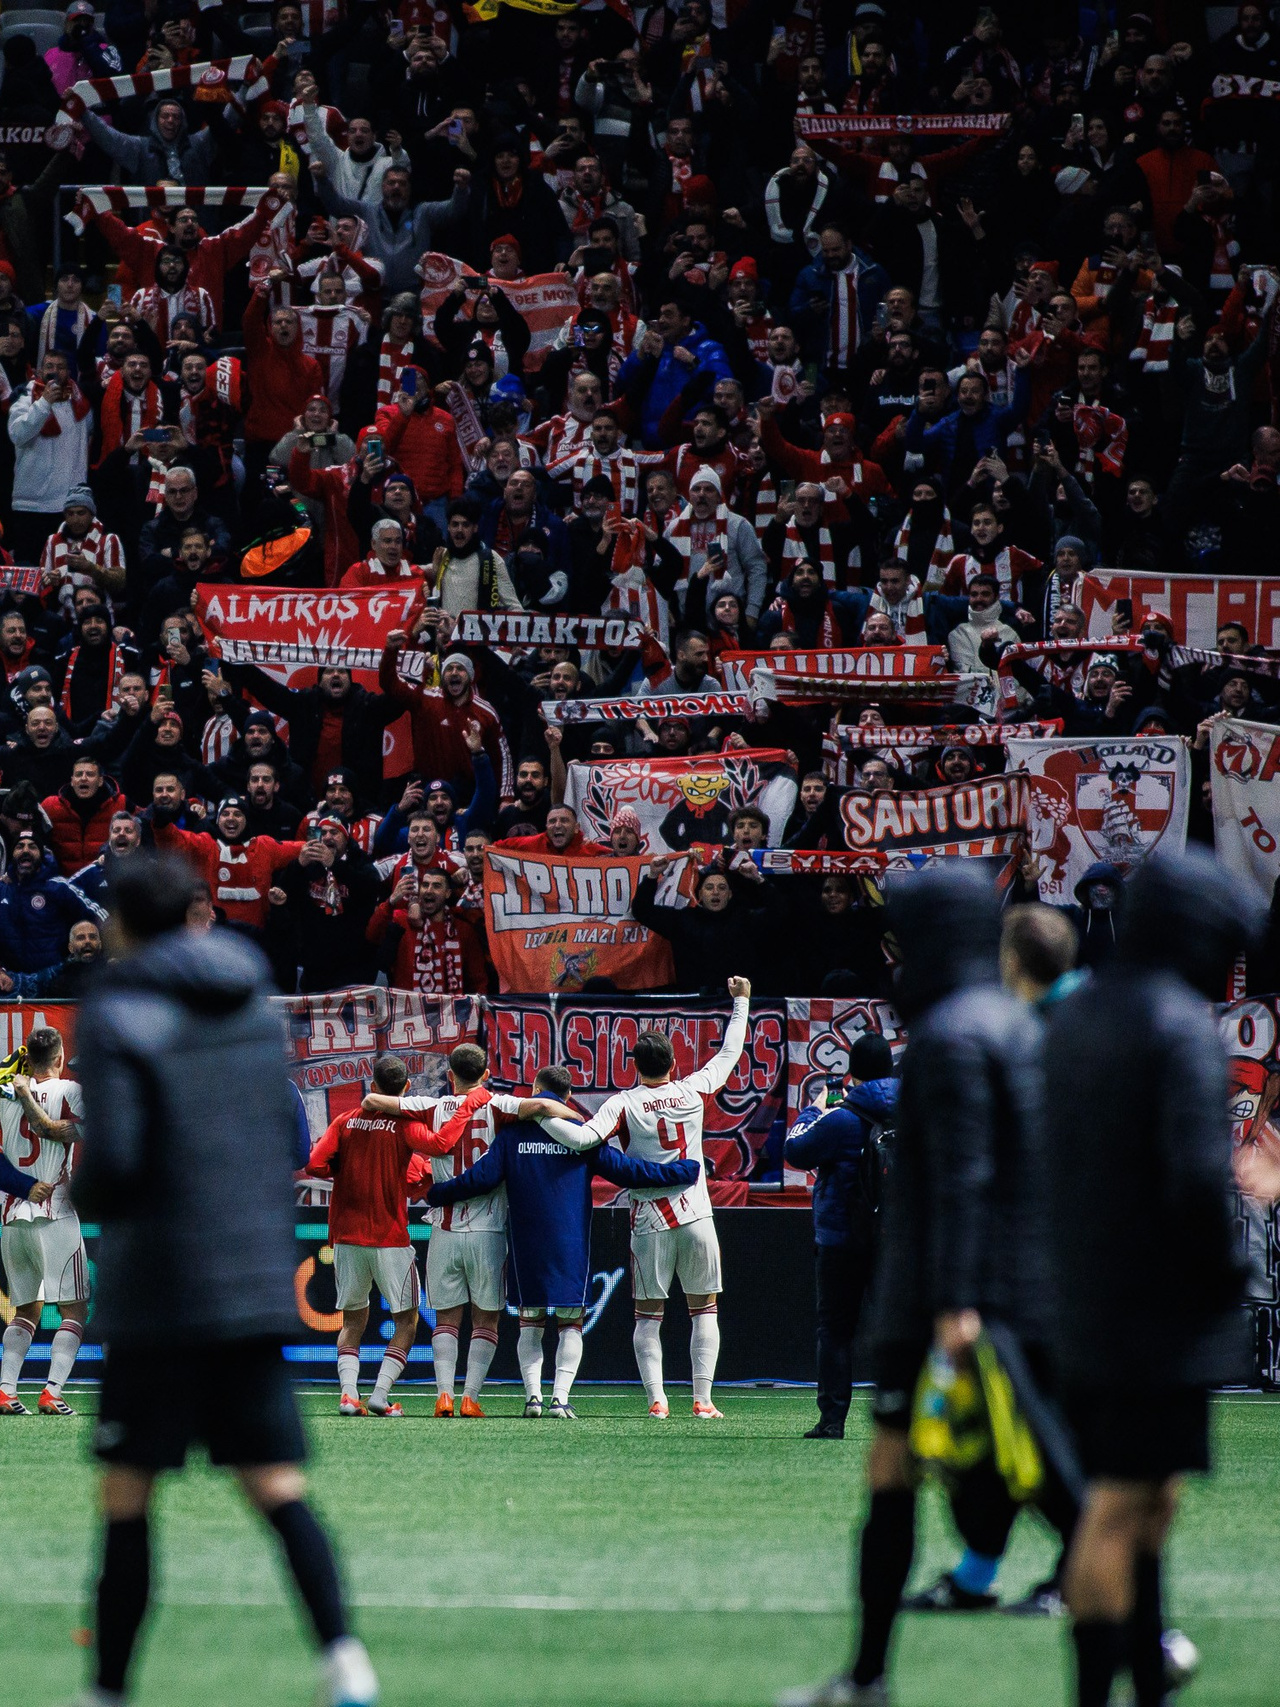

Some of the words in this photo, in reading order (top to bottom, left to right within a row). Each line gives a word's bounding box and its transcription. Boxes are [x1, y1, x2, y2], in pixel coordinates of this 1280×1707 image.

[205, 592, 360, 627] ALMIROS
[452, 613, 644, 647] ΑΥΠΑΚΤΟΣ
[1078, 743, 1177, 765] HOLLAND
[518, 1141, 568, 1156] OLYMPIACOS
